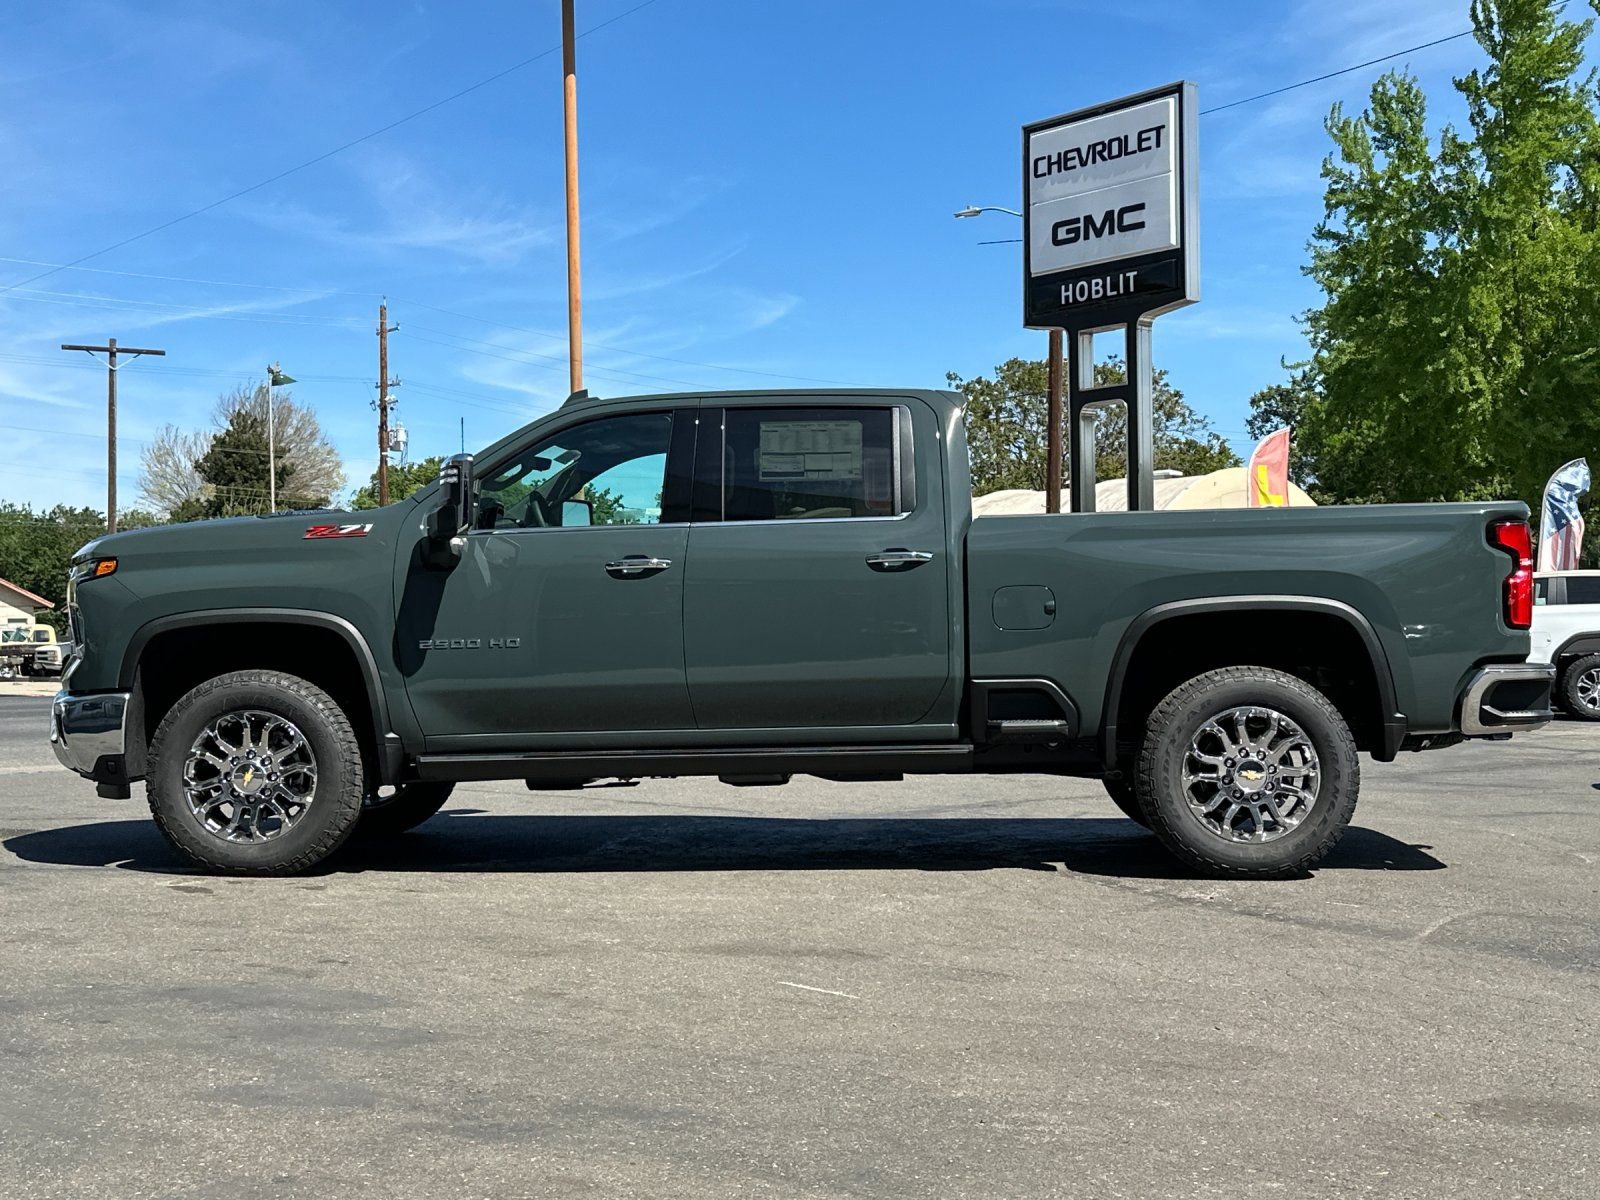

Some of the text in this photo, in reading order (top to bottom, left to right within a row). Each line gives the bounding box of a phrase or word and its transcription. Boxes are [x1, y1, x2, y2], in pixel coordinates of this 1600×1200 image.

[1033, 125, 1166, 178] CHEVROLET
[1051, 202, 1146, 247] GMC
[1061, 271, 1138, 305] HOBLIT
[303, 523, 374, 540] Z71
[418, 638, 520, 650] 2500 HD
